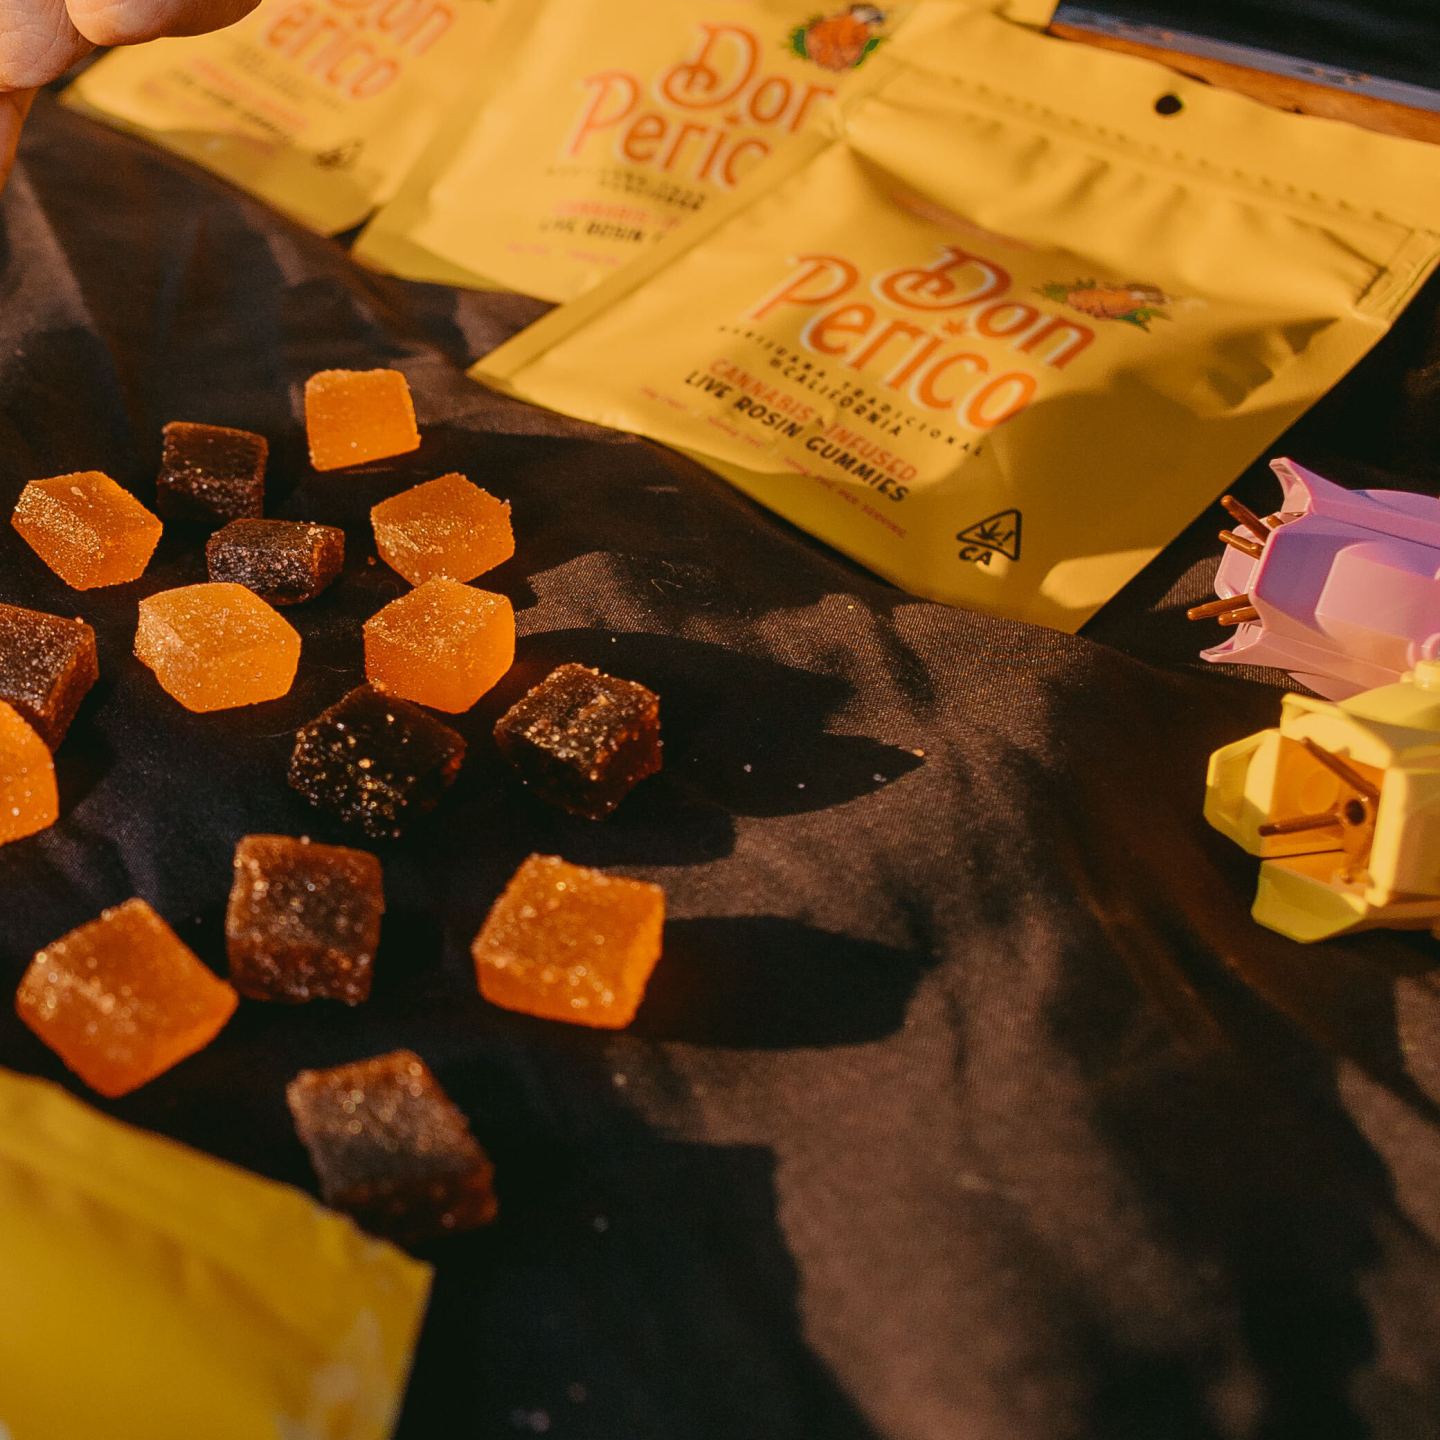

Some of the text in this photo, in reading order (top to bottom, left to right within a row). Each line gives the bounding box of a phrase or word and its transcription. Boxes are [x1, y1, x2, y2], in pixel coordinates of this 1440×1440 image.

[741, 252, 1038, 433] Perico
[869, 244, 1096, 371] Don
[685, 369, 909, 503] LIVE ROSIN GUMMIES
[782, 366, 902, 437] CALIFORNIA
[959, 547, 992, 566] CA
